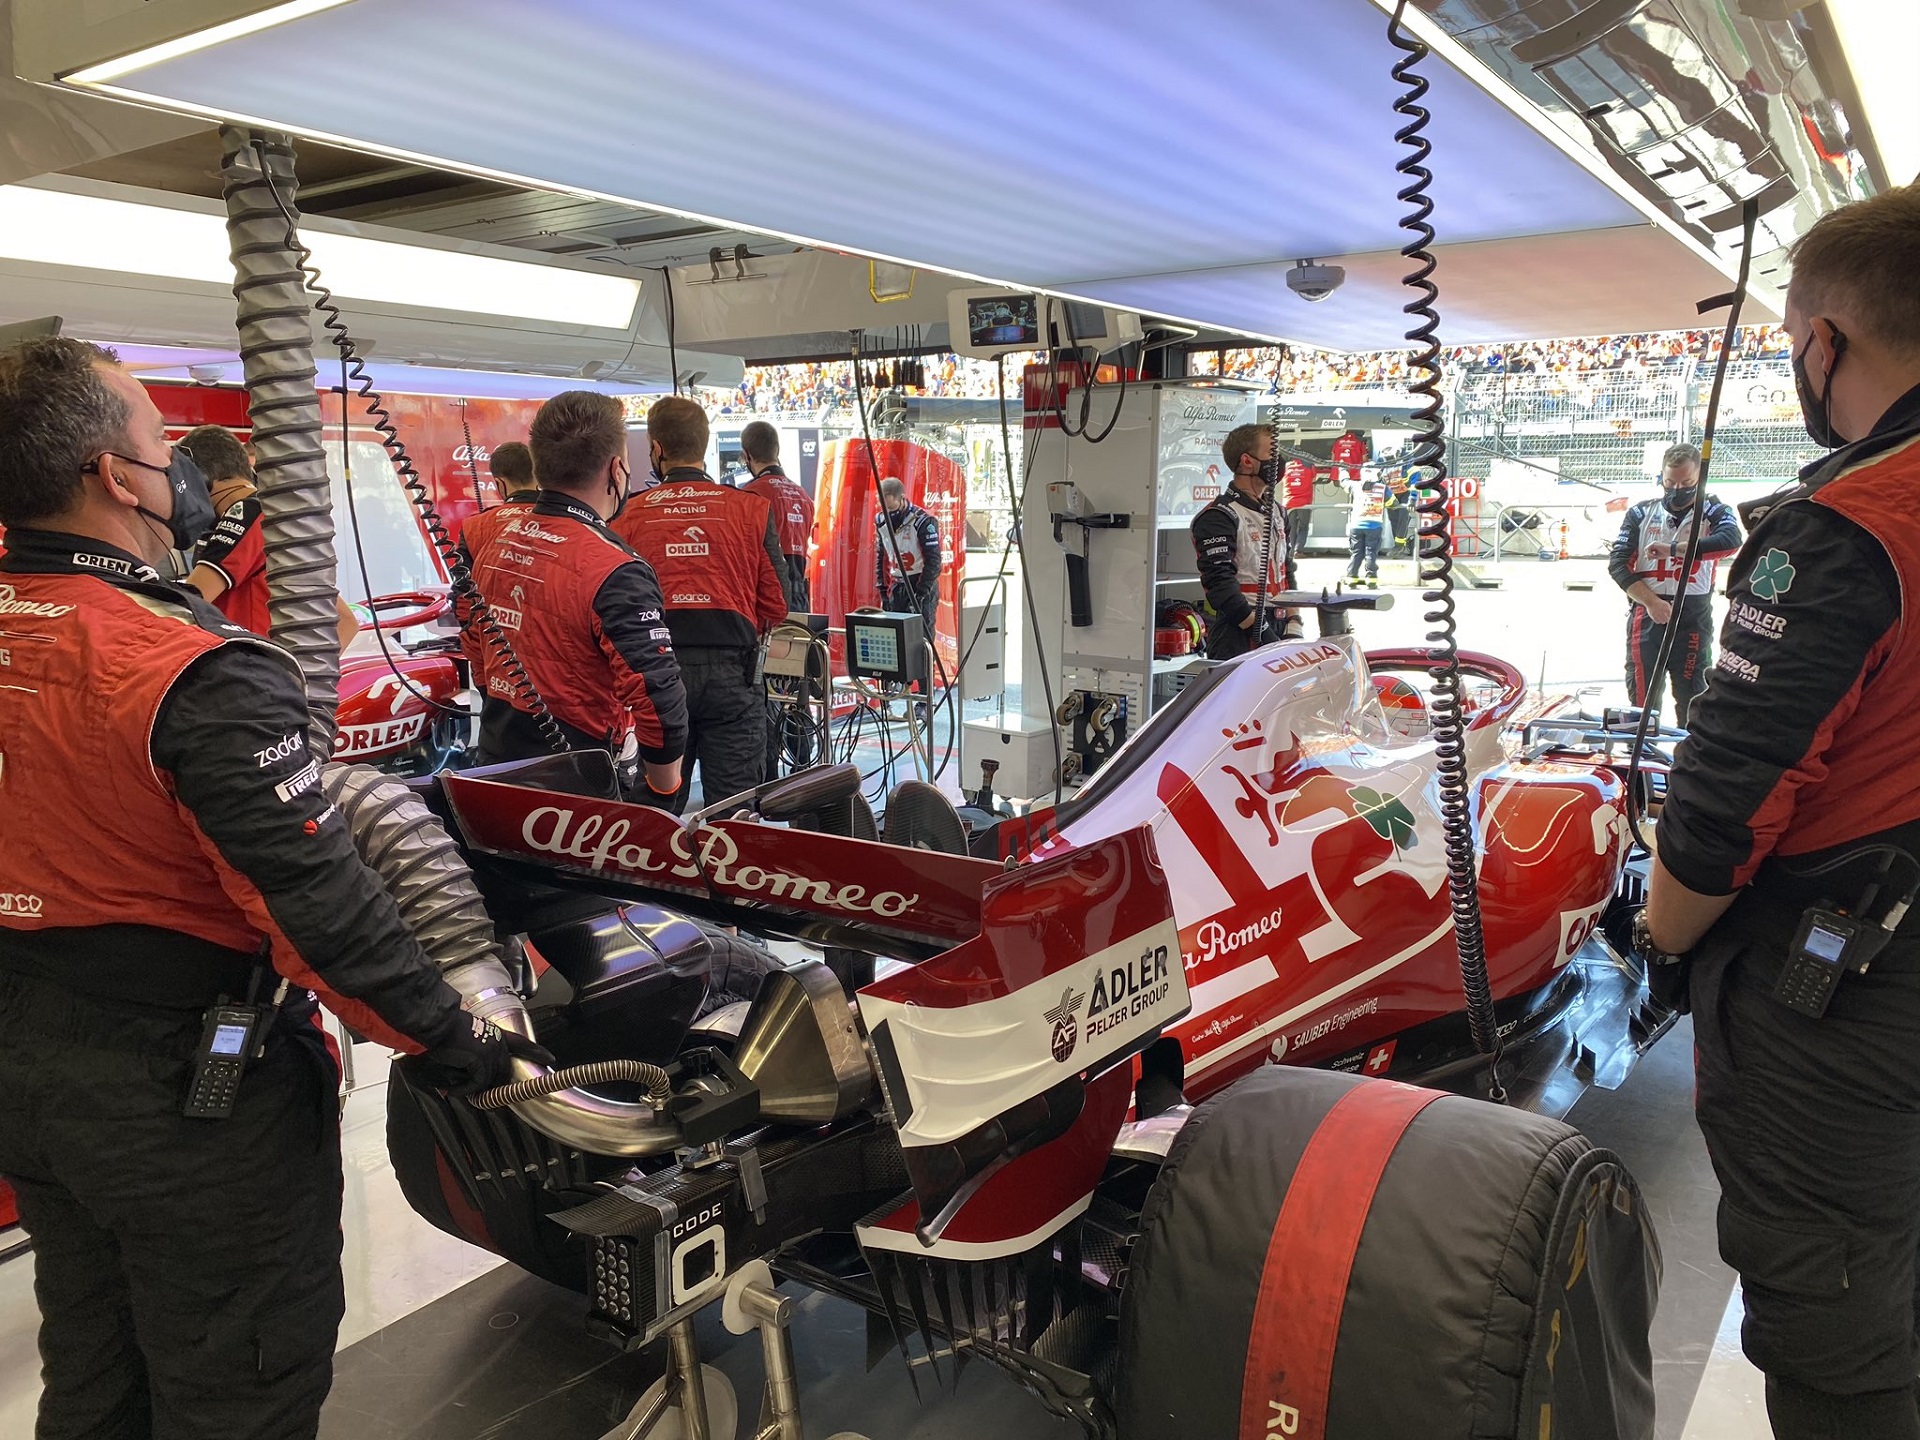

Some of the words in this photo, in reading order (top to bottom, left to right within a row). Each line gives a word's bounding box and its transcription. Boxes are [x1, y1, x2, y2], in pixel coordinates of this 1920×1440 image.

[1183, 405, 1205, 425] Alfa
[1205, 405, 1237, 422] Romeo
[645, 489, 677, 503] Alfa
[676, 486, 725, 499] Romeo
[1194, 487, 1220, 499] ORLEN
[663, 506, 707, 515] RACING
[520, 520, 568, 544] Romeo
[668, 544, 706, 555] ORLEN
[77, 553, 128, 575] ORLEN
[1738, 602, 1788, 633] ADLER
[1688, 631, 1700, 651] PIT
[1753, 624, 1783, 640] GROUP
[1261, 645, 1342, 674] GIULIA
[1683, 652, 1697, 680] CREW
[832, 692, 854, 706] RLEN
[334, 718, 420, 753] ORLEN
[522, 806, 668, 870] Alfa
[669, 824, 920, 917] Romeo
[0, 893, 43, 913] arco
[1196, 906, 1283, 962] Romeo
[1087, 944, 1168, 1019] ADLER
[1086, 1006, 1128, 1044] PELZER
[1131, 982, 1169, 1018] GROUP
[1291, 1019, 1331, 1051] SAUBER
[1330, 997, 1379, 1031] Engineering
[1331, 1052, 1365, 1069] Schweiz
[1337, 1064, 1360, 1073] isse
[673, 1202, 722, 1238] CODE
